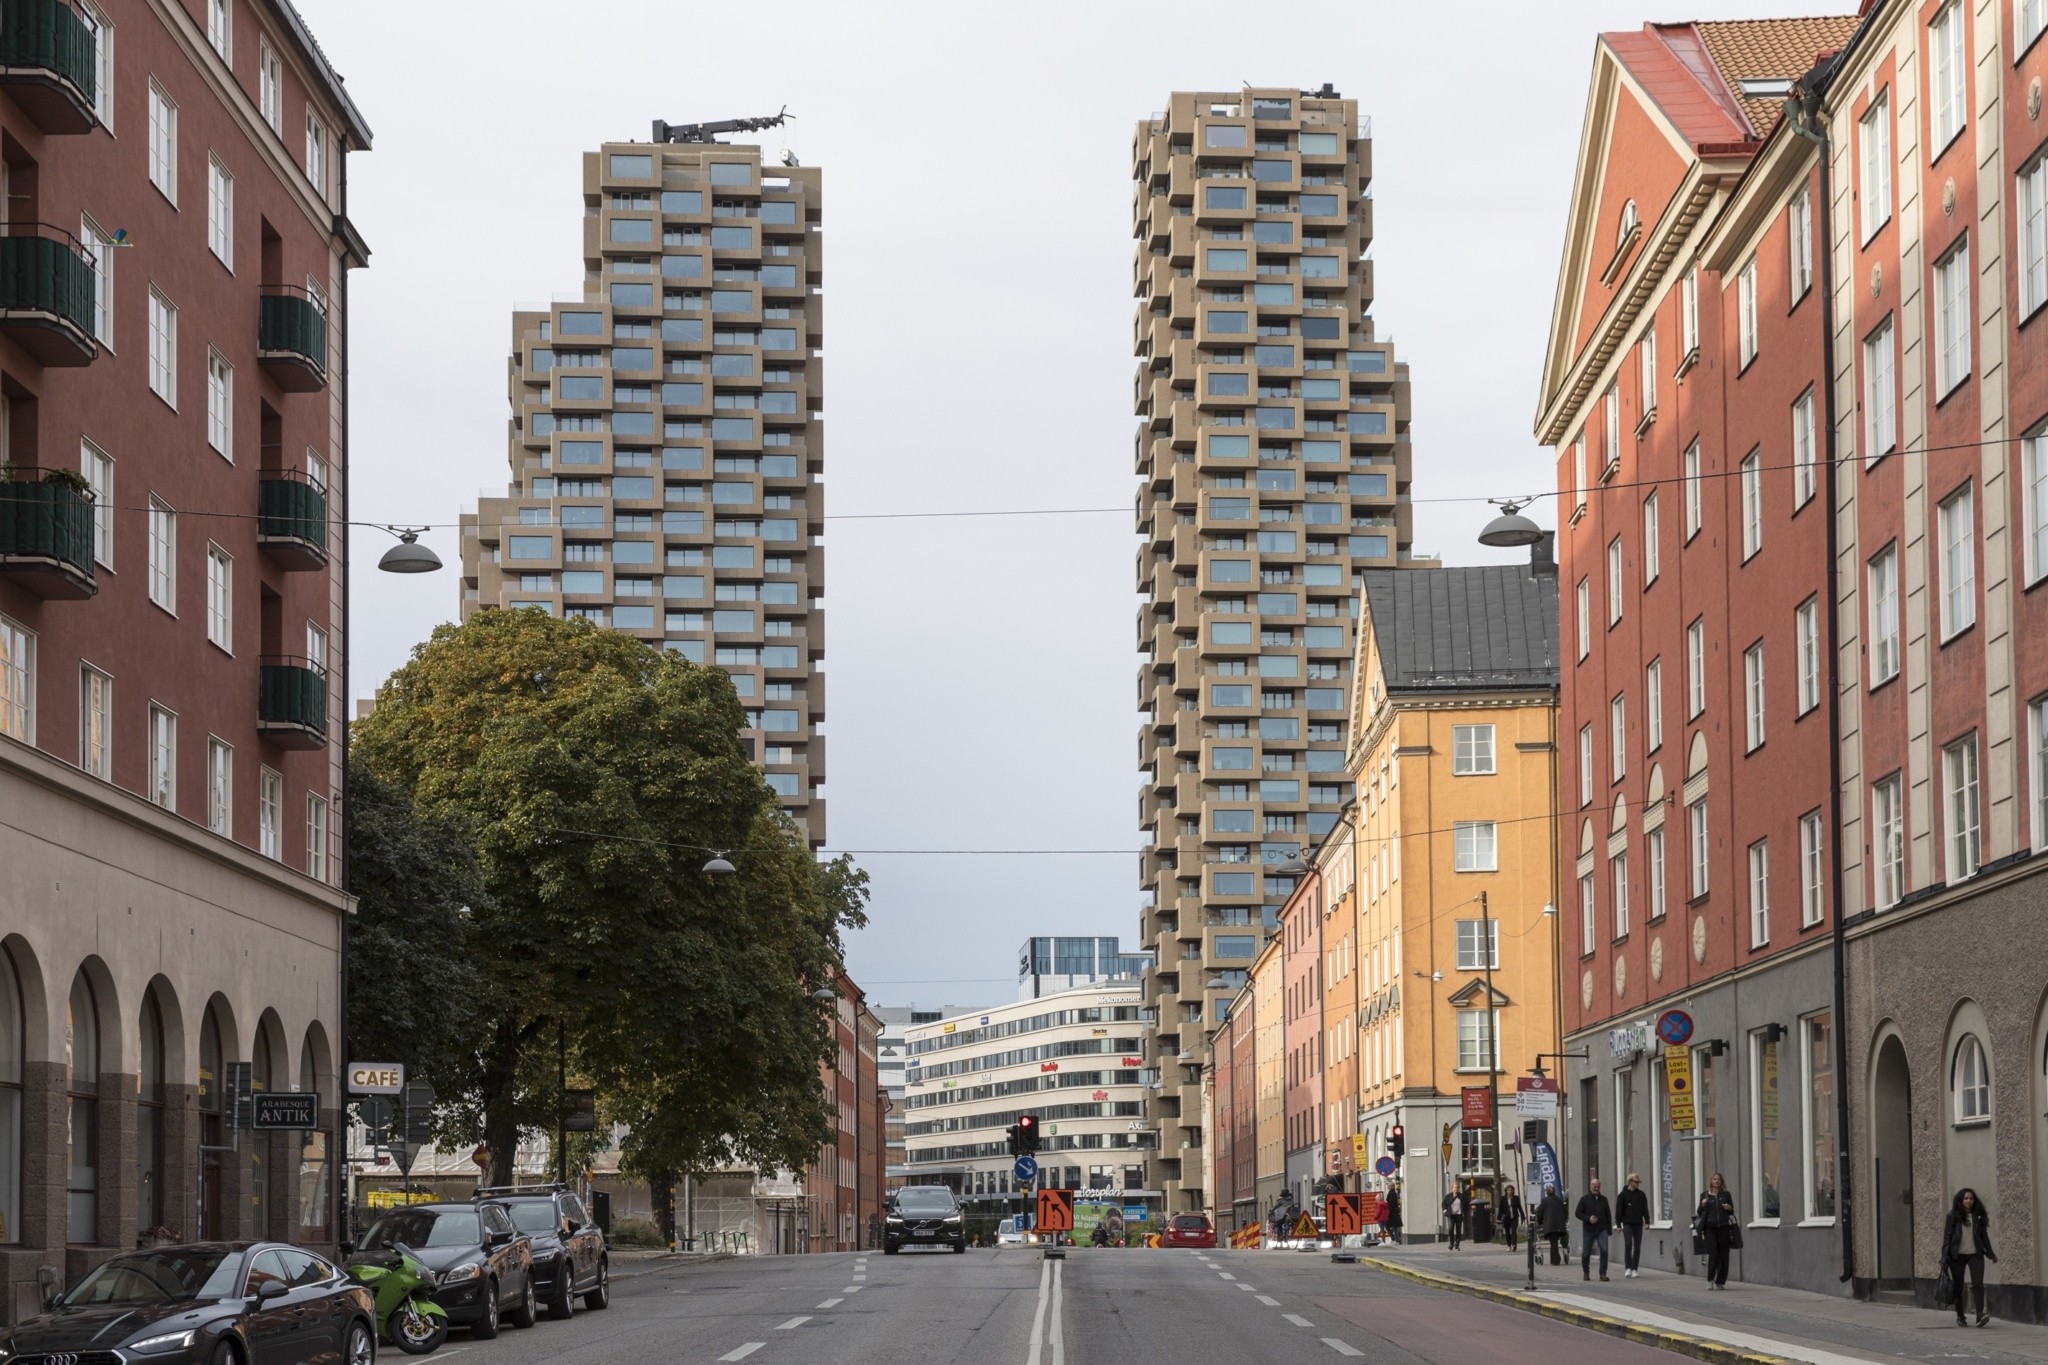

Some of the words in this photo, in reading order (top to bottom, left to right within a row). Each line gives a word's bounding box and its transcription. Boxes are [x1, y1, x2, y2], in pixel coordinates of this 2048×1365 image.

[353, 1068, 398, 1086] CAFÉ
[262, 1100, 310, 1108] ARABESQUE
[260, 1109, 309, 1121] ANTIK
